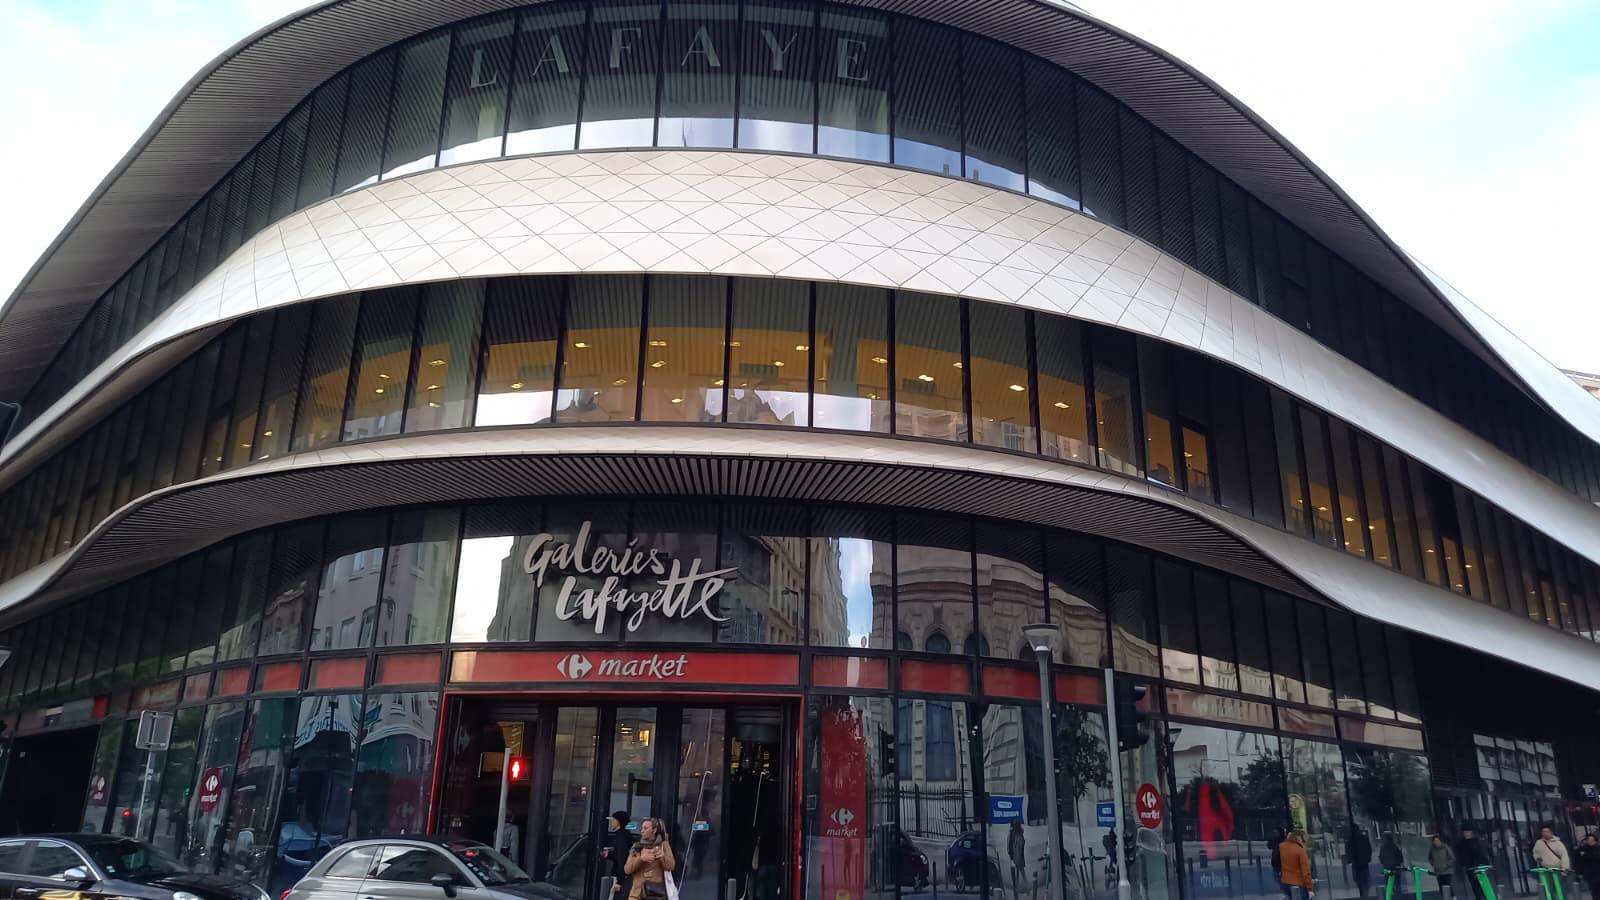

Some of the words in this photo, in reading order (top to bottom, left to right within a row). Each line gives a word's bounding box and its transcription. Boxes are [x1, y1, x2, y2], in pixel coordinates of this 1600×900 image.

[524, 520, 665, 587] Galeries
[555, 558, 739, 634] Lafayette
[597, 654, 688, 678] market
[826, 827, 858, 838] market
